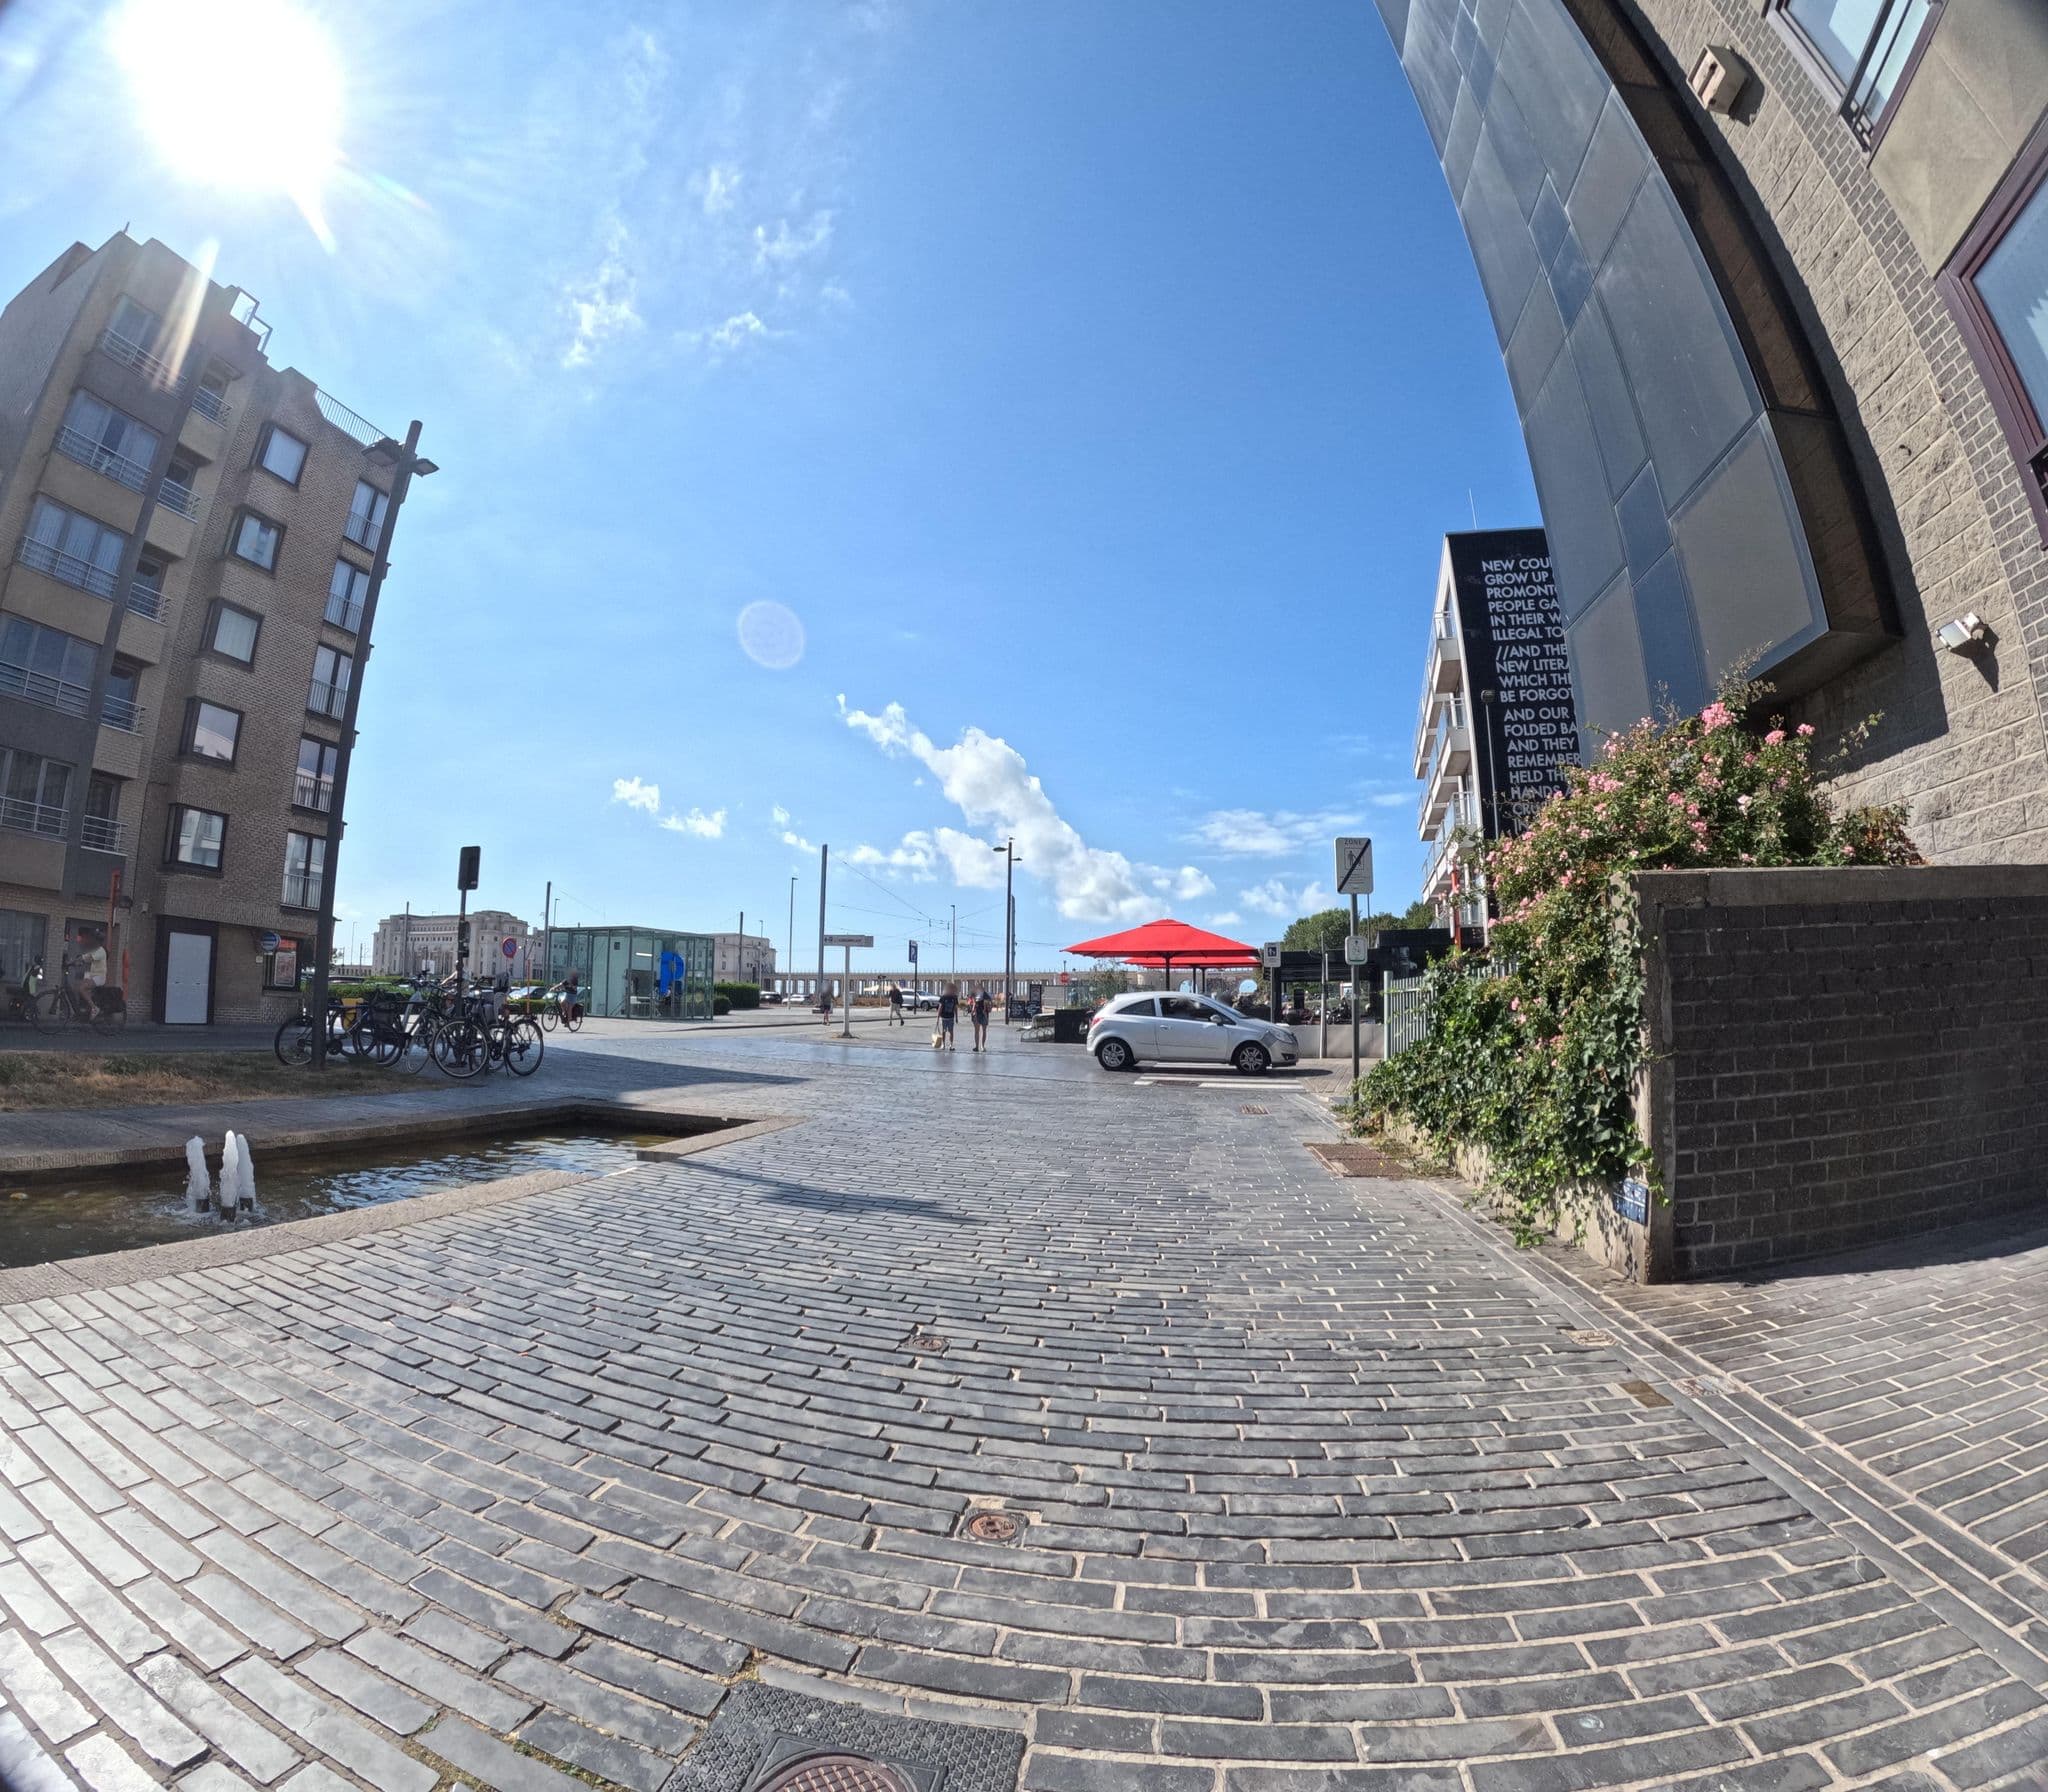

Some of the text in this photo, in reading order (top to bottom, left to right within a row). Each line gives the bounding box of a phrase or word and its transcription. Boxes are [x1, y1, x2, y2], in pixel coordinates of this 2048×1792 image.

[1482, 559, 1514, 572] NEW
[1485, 571, 1548, 585] GROW UP
[1488, 598, 1560, 612] PEOPLE GA
[1490, 615, 1506, 626] IN
[1508, 612, 1545, 625] THEIR
[1492, 626, 1563, 641] ILLEGAL TO
[1496, 645, 1540, 660] //AND
[1496, 659, 1529, 673] NEW
[1499, 674, 1547, 688] WHICH
[1500, 690, 1516, 703] BE
[1504, 706, 1570, 722] AND OUR
[1504, 721, 1578, 737] FOLDED BA
[1507, 737, 1575, 753] AND THEY
[1507, 752, 1582, 768] REMEMBER
[1509, 770, 1543, 783] HELD
